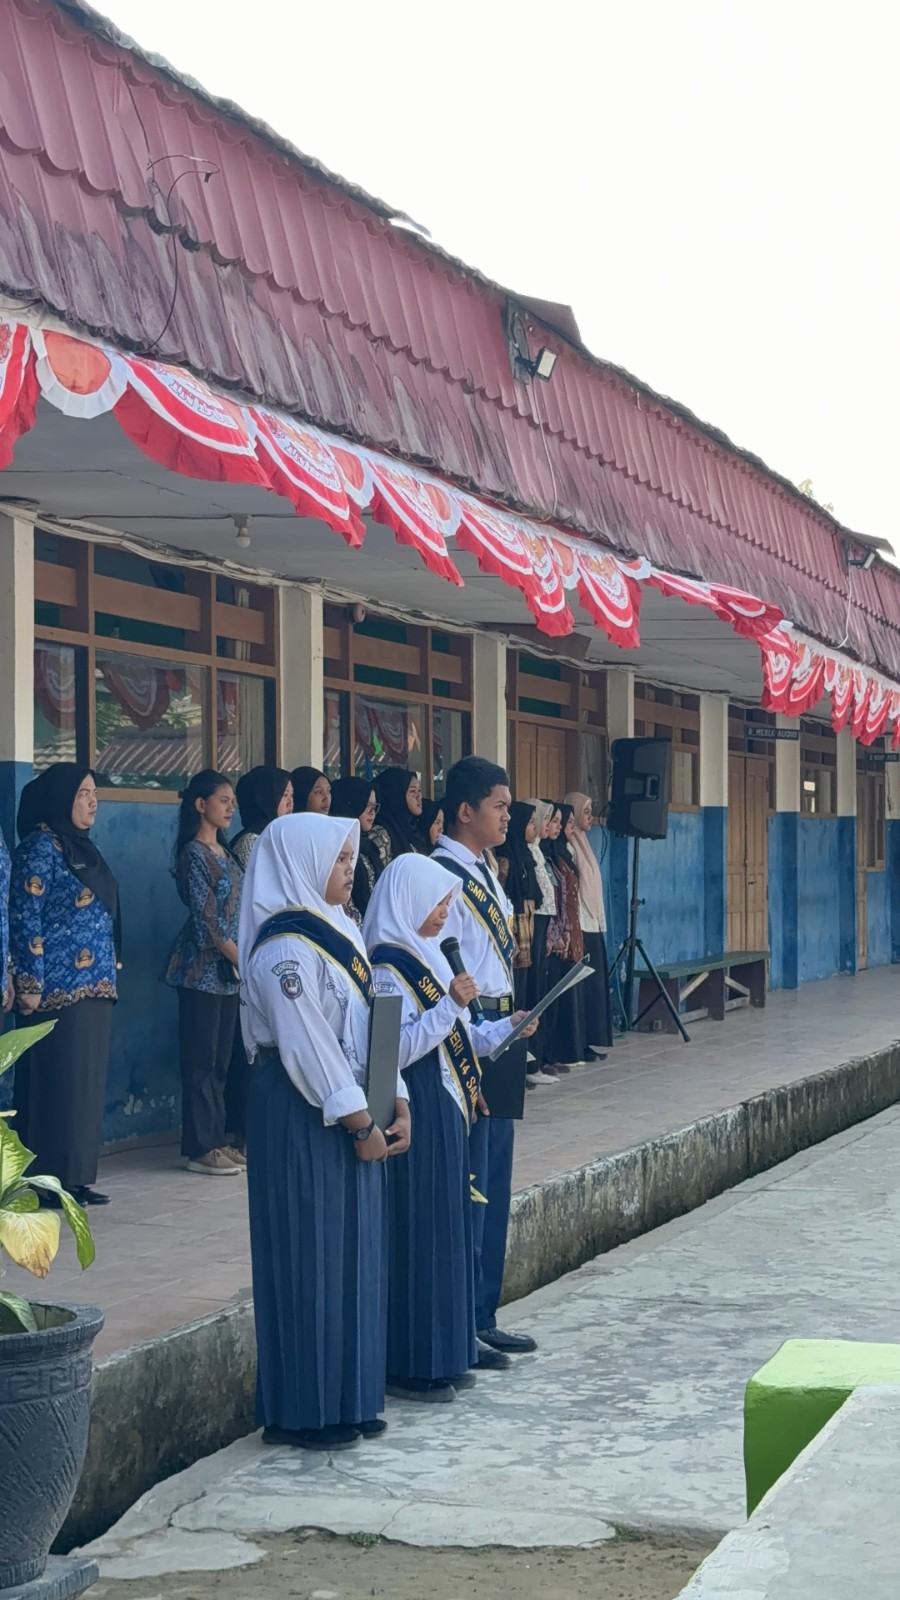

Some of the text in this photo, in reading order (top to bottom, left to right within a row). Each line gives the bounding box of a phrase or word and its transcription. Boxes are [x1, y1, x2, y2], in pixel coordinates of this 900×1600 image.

[467, 880, 487, 903] SMP
[351, 955, 368, 983] SMP
[418, 976, 441, 1003] SMP
[459, 1058, 470, 1075] 14
